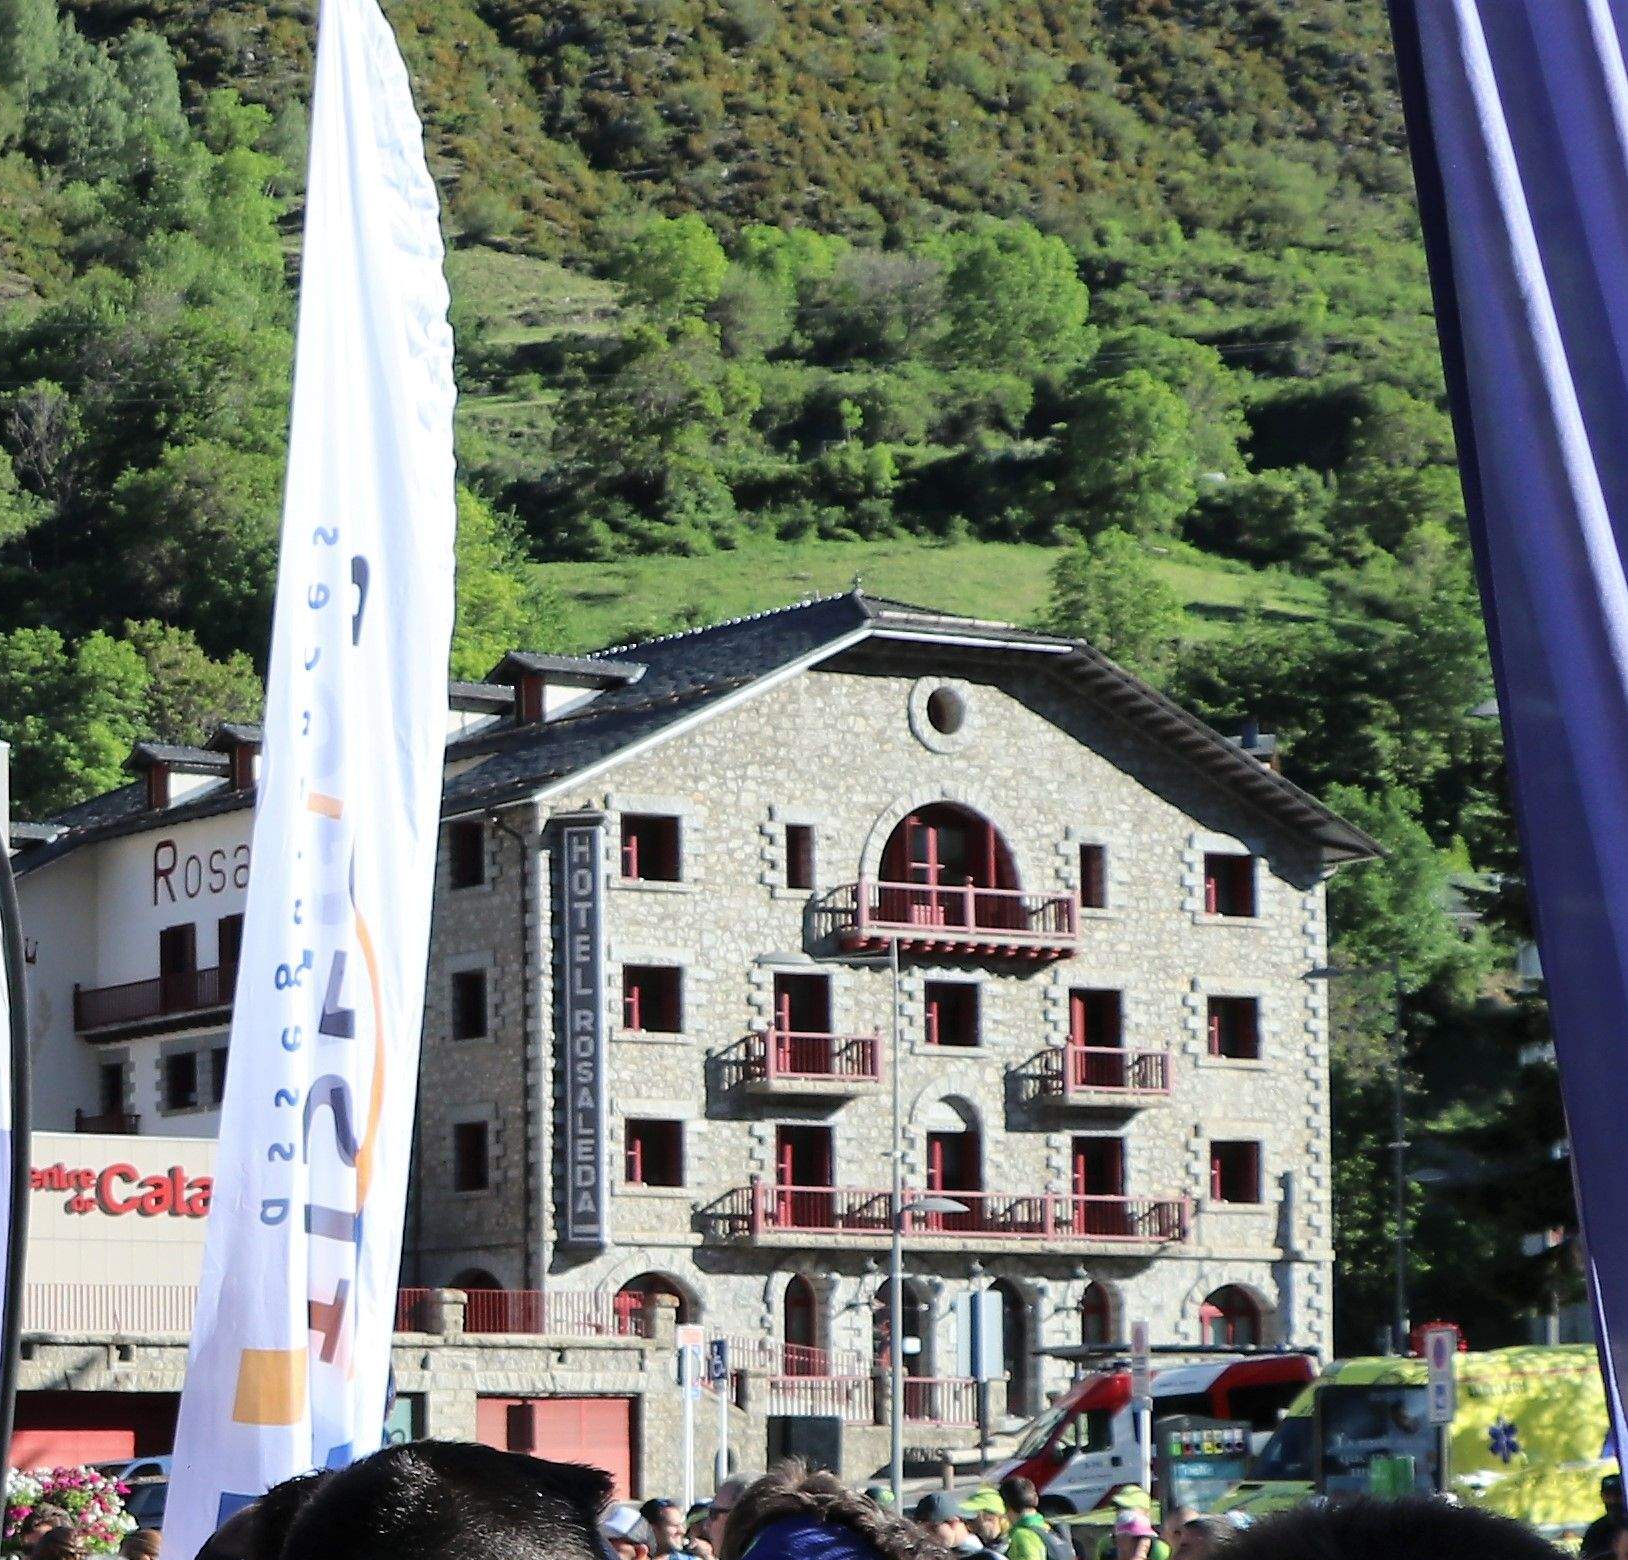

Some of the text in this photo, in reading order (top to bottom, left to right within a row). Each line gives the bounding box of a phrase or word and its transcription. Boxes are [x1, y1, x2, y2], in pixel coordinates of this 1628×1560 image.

[154, 839, 250, 906] Rosa
[572, 834, 597, 1214] HOTEL ROSALEDA
[30, 1162, 214, 1218] entre Cata
